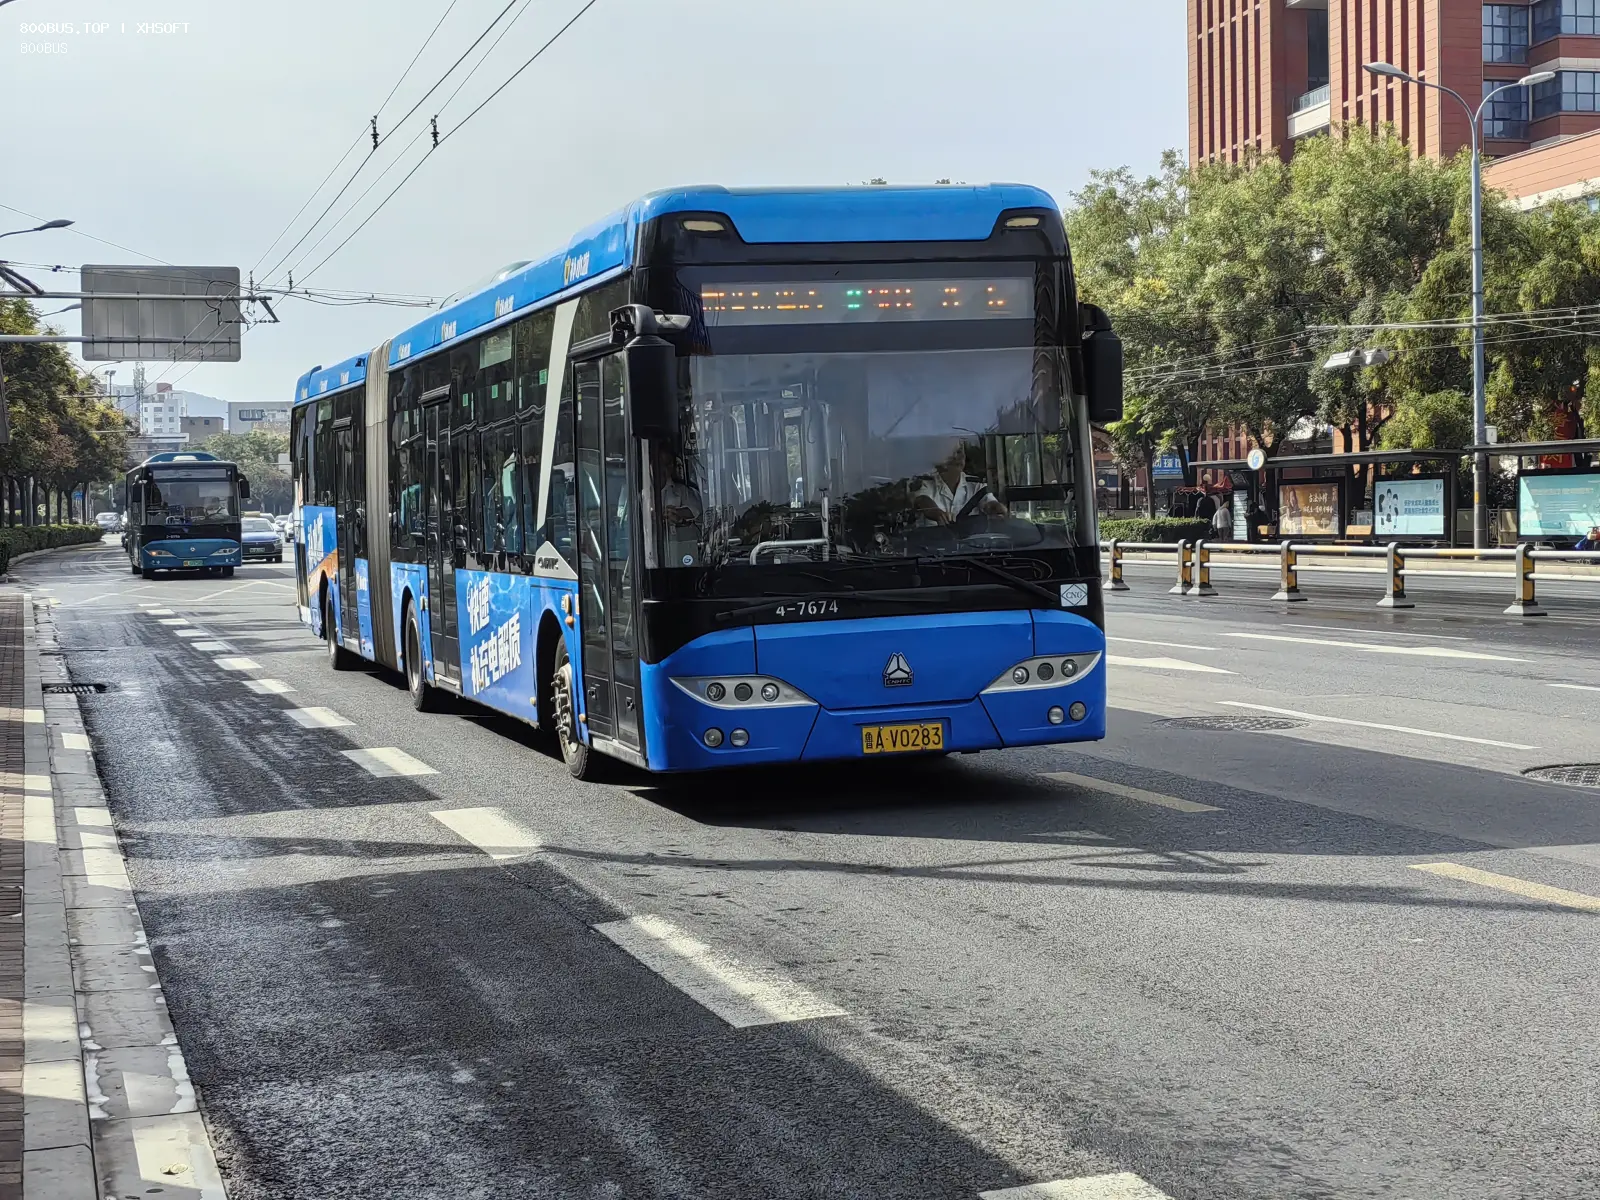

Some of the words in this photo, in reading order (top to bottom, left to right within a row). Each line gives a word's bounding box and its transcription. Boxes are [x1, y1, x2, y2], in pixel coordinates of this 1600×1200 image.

[1065, 590, 1084, 600] CNG
[775, 599, 839, 617] 4-7674
[470, 611, 522, 696] 补充电解质
